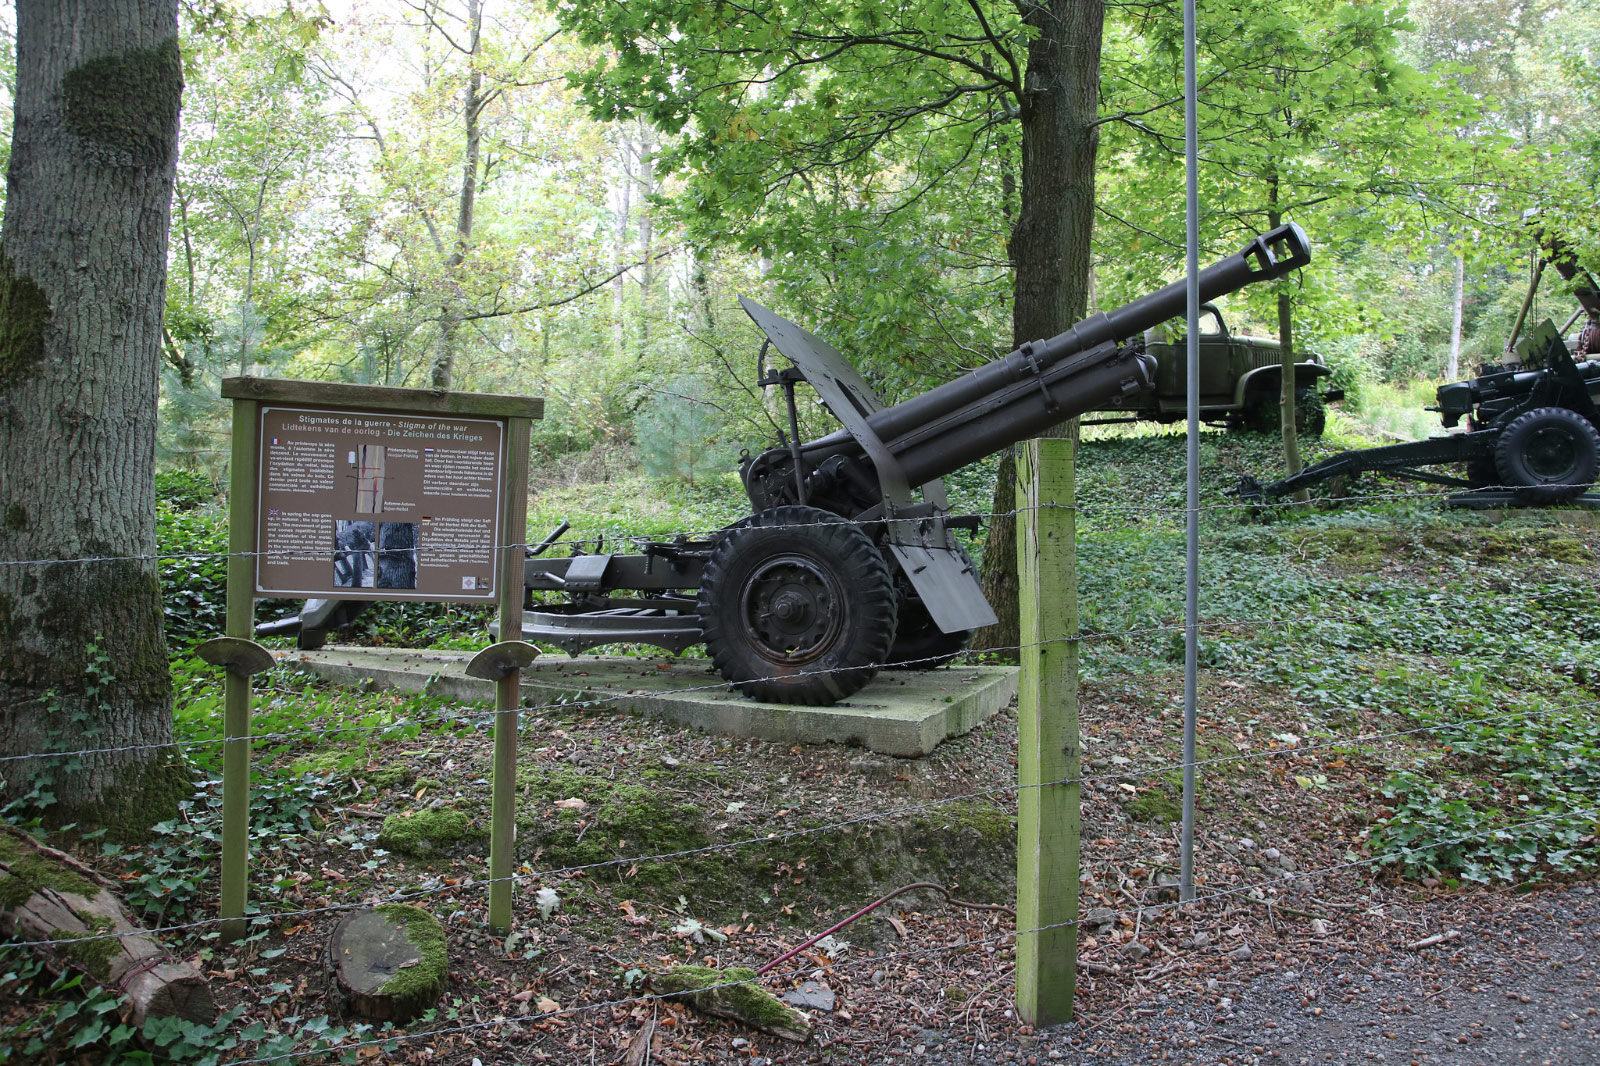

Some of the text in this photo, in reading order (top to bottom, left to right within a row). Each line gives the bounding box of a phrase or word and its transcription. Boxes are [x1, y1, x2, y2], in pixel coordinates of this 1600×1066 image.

[299, 416, 339, 424] Stigmates
[364, 420, 390, 428] guerre
[398, 421, 425, 430] Stigma
[282, 424, 322, 432] Lidtekens
[354, 427, 380, 436] oorlog
[403, 430, 434, 438] Zeichen
[453, 433, 482, 442] Krieges
